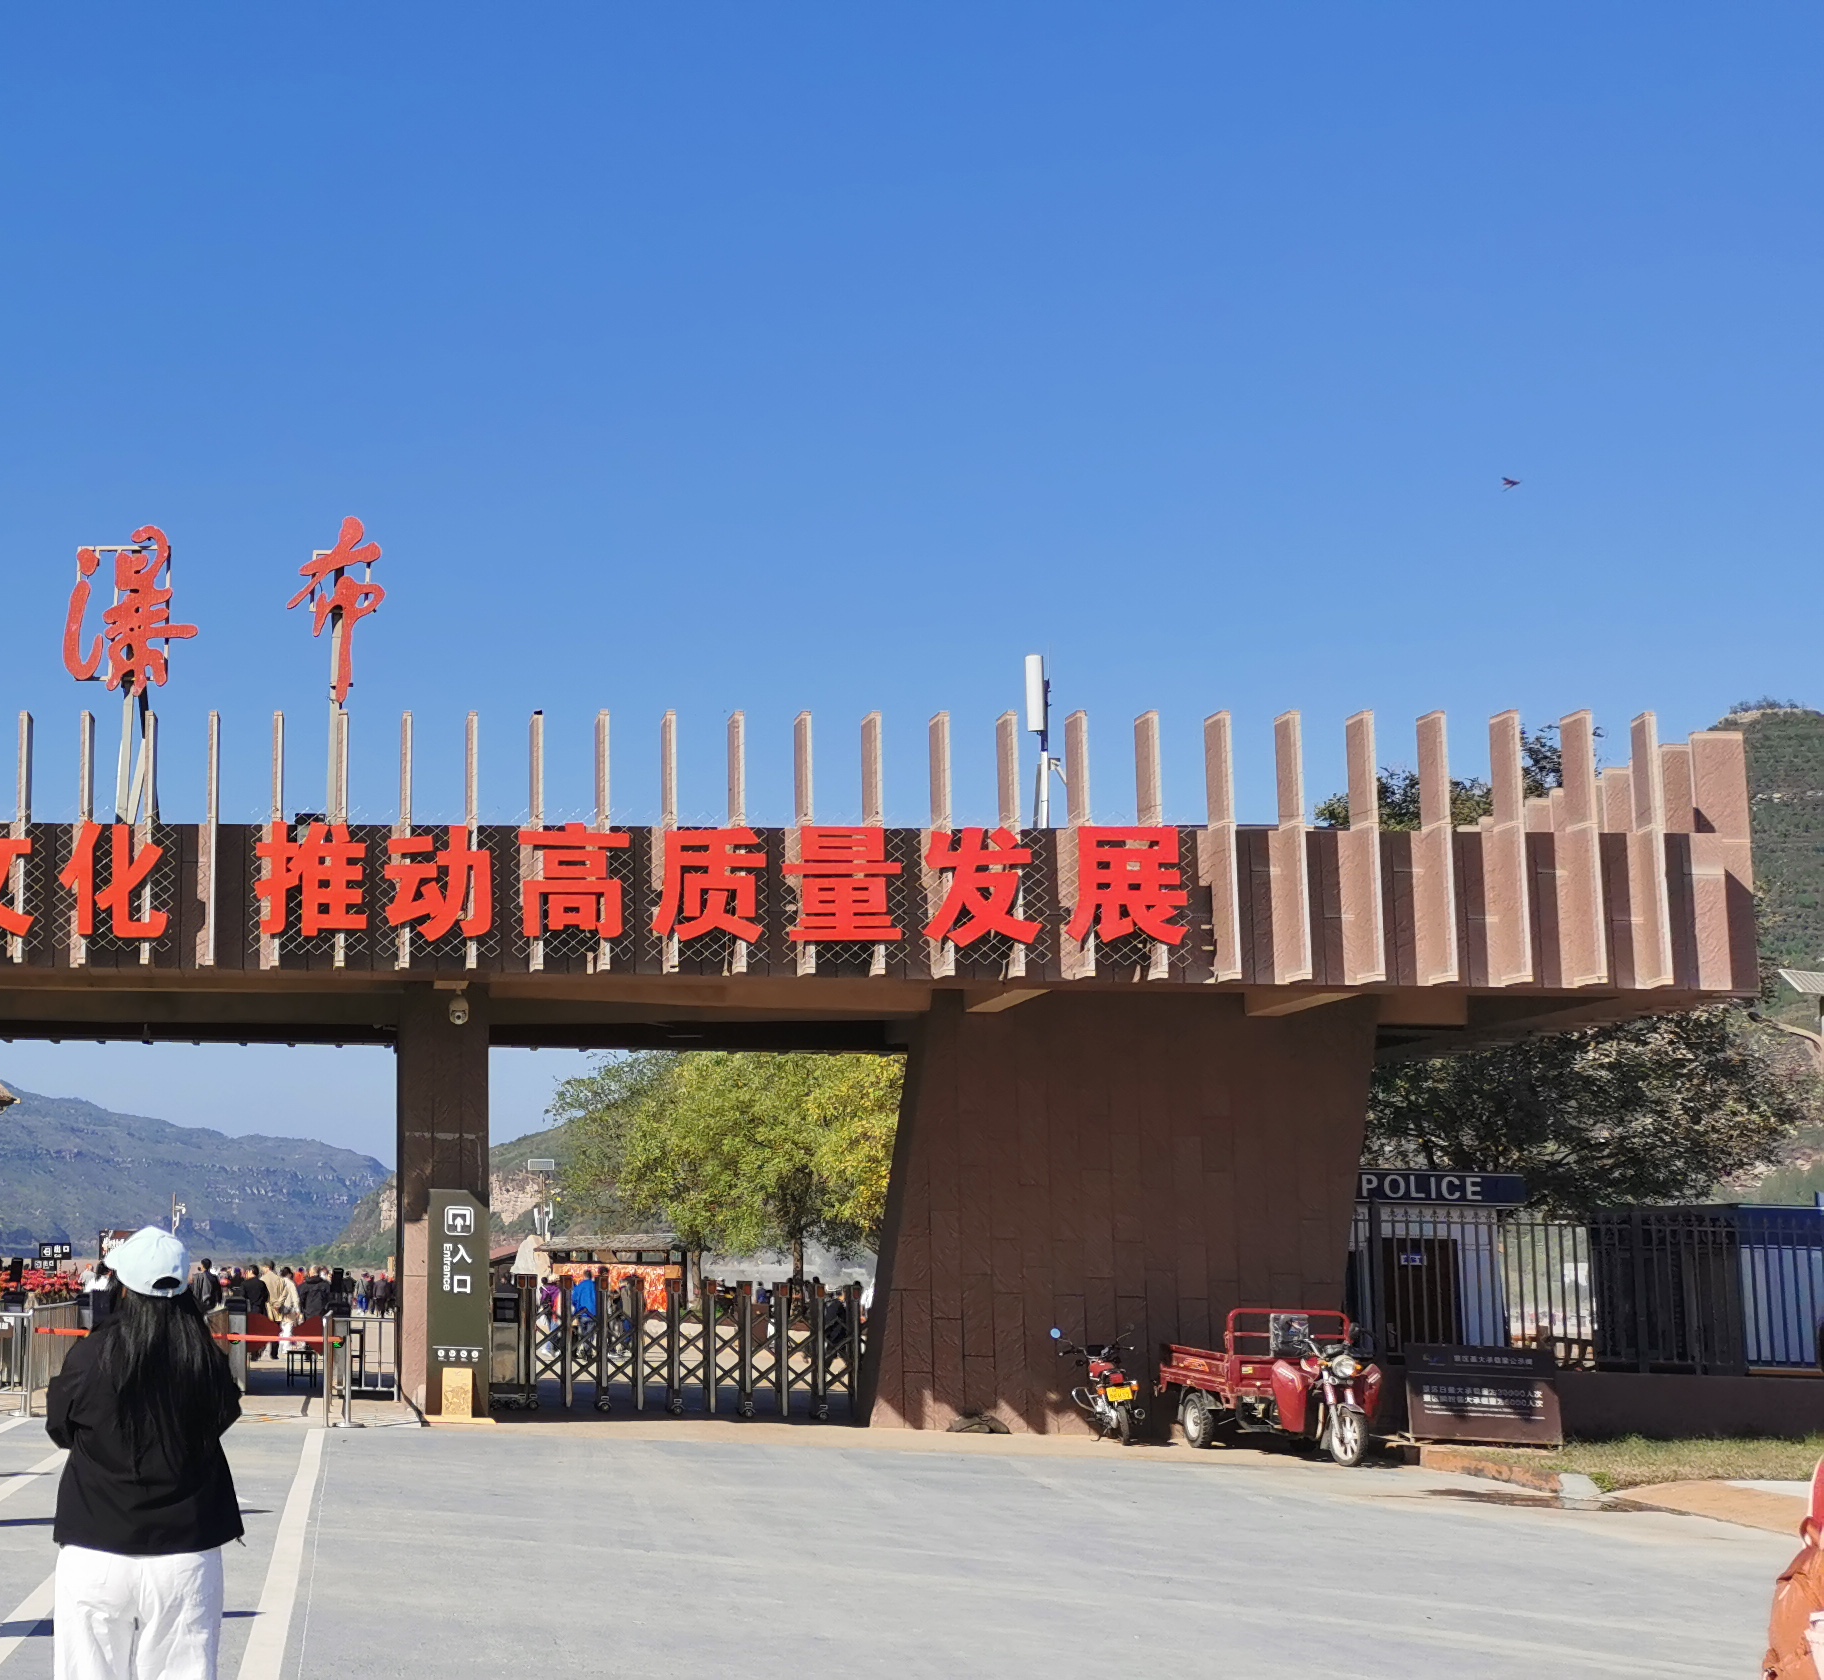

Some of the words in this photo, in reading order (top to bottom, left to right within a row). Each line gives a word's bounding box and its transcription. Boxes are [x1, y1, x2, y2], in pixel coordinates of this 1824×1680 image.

[254, 820, 1189, 947] 推动高质量发展
[1361, 1174, 1483, 1201] POLICE
[442, 1243, 453, 1292] Entrance
[452, 1243, 473, 1295] 入口
